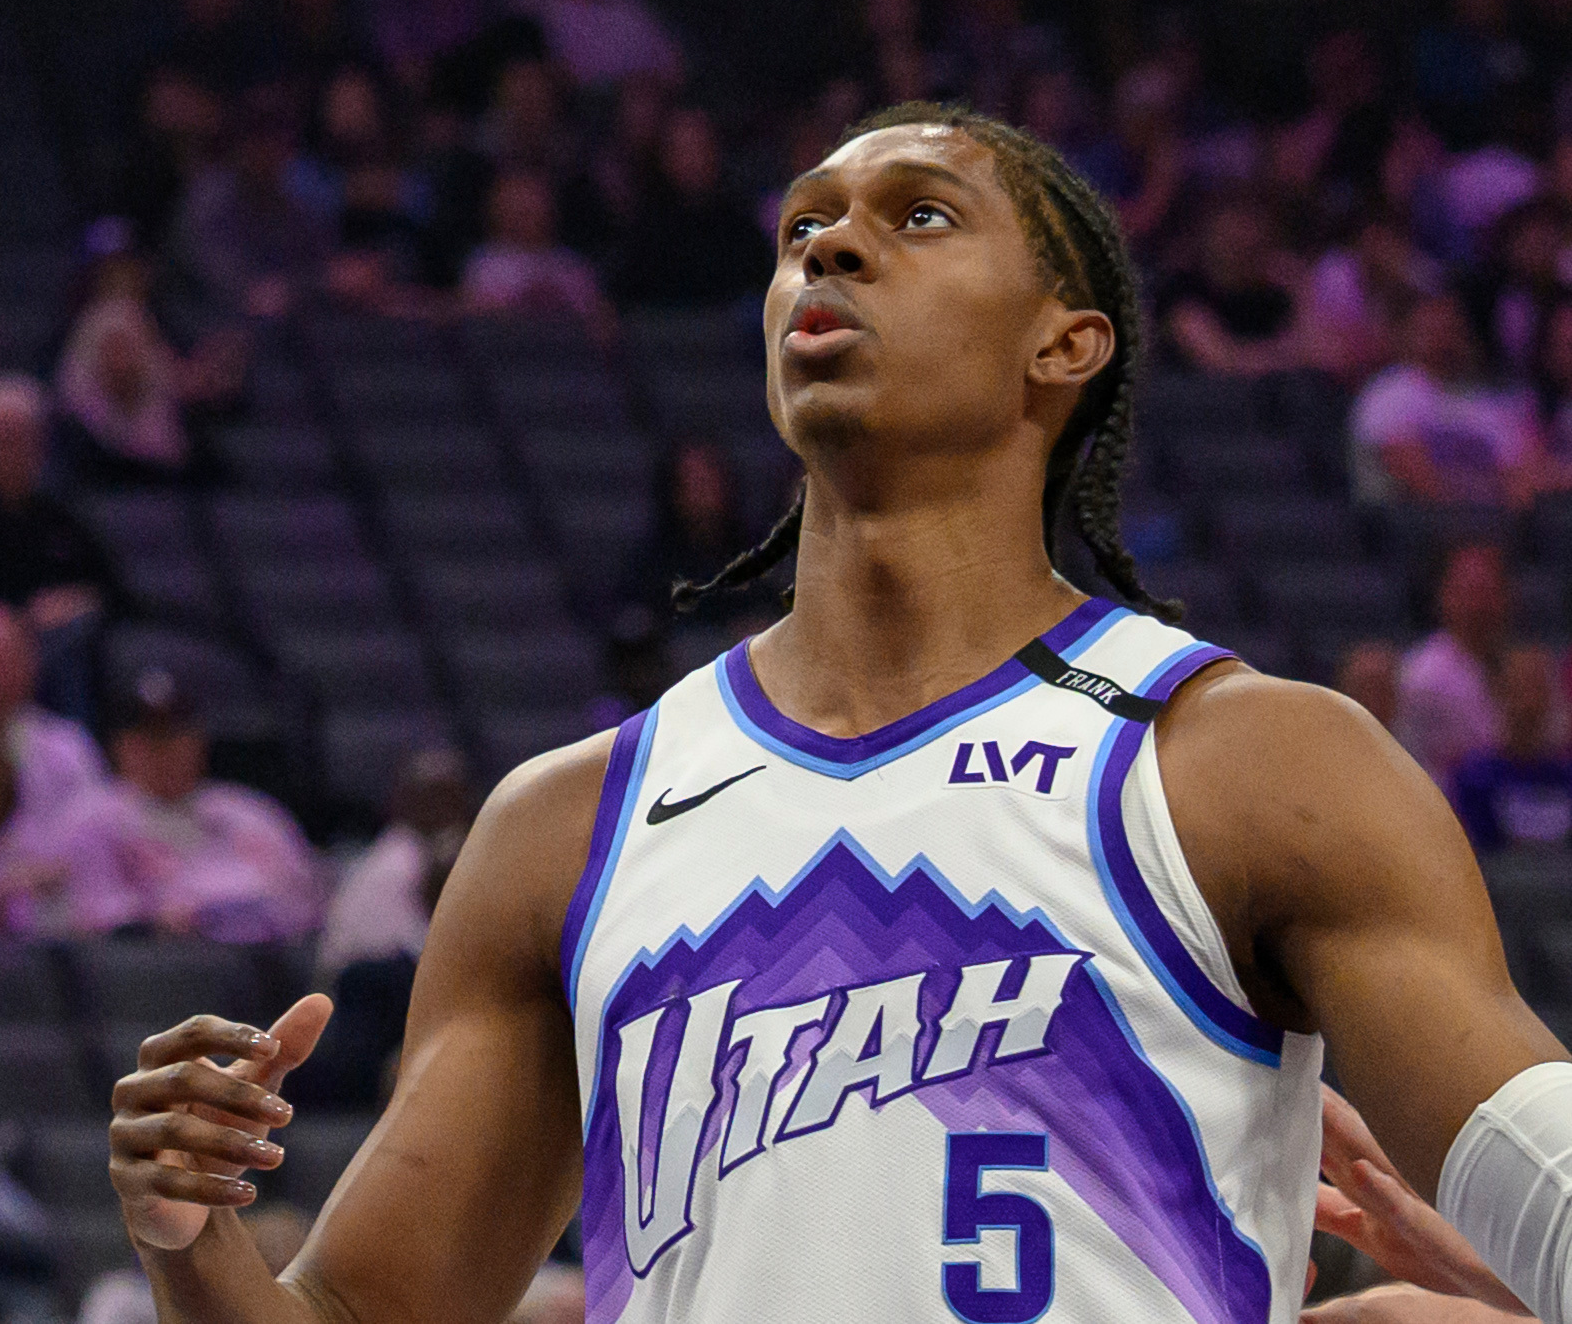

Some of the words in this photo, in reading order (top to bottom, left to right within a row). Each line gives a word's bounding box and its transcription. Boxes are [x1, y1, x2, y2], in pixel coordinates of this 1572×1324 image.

[1055, 669, 1122, 705] FRANK
[947, 740, 1078, 795] LVT
[613, 949, 1096, 1280] UTAH
[941, 1130, 1055, 1324] 5
